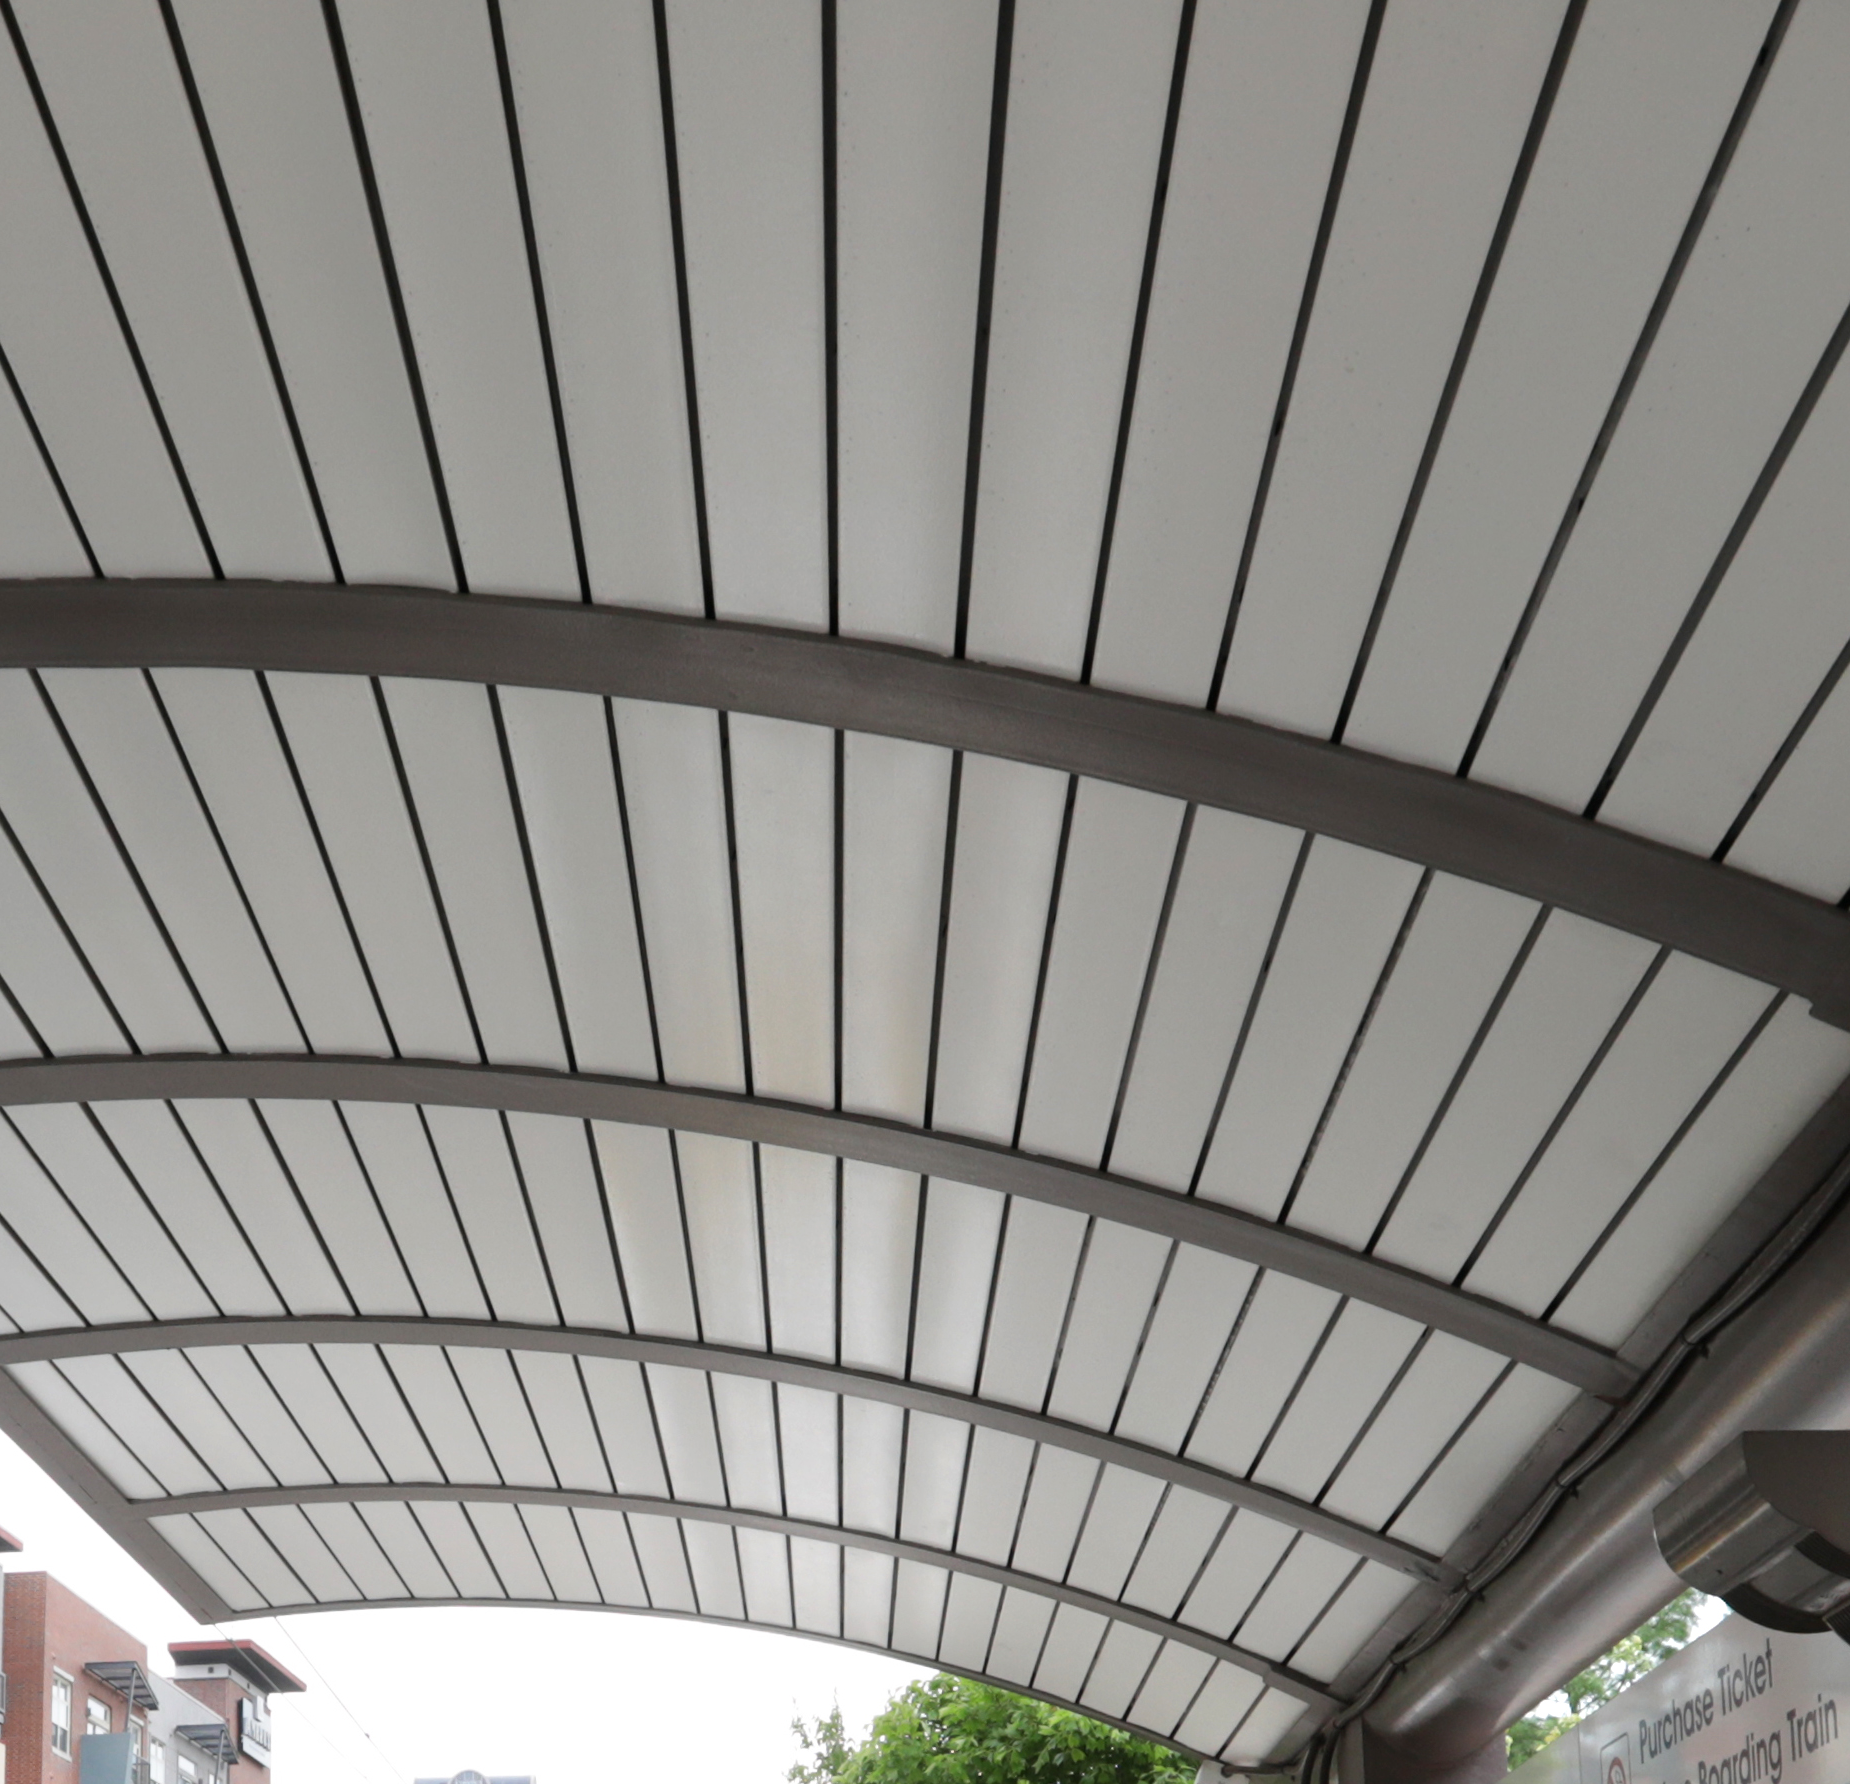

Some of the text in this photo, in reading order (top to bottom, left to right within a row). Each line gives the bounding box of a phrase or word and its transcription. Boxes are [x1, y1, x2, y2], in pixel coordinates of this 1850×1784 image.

[1638, 1637, 1773, 1764] Purchase Ticket
[1786, 1692, 1839, 1762] Train
